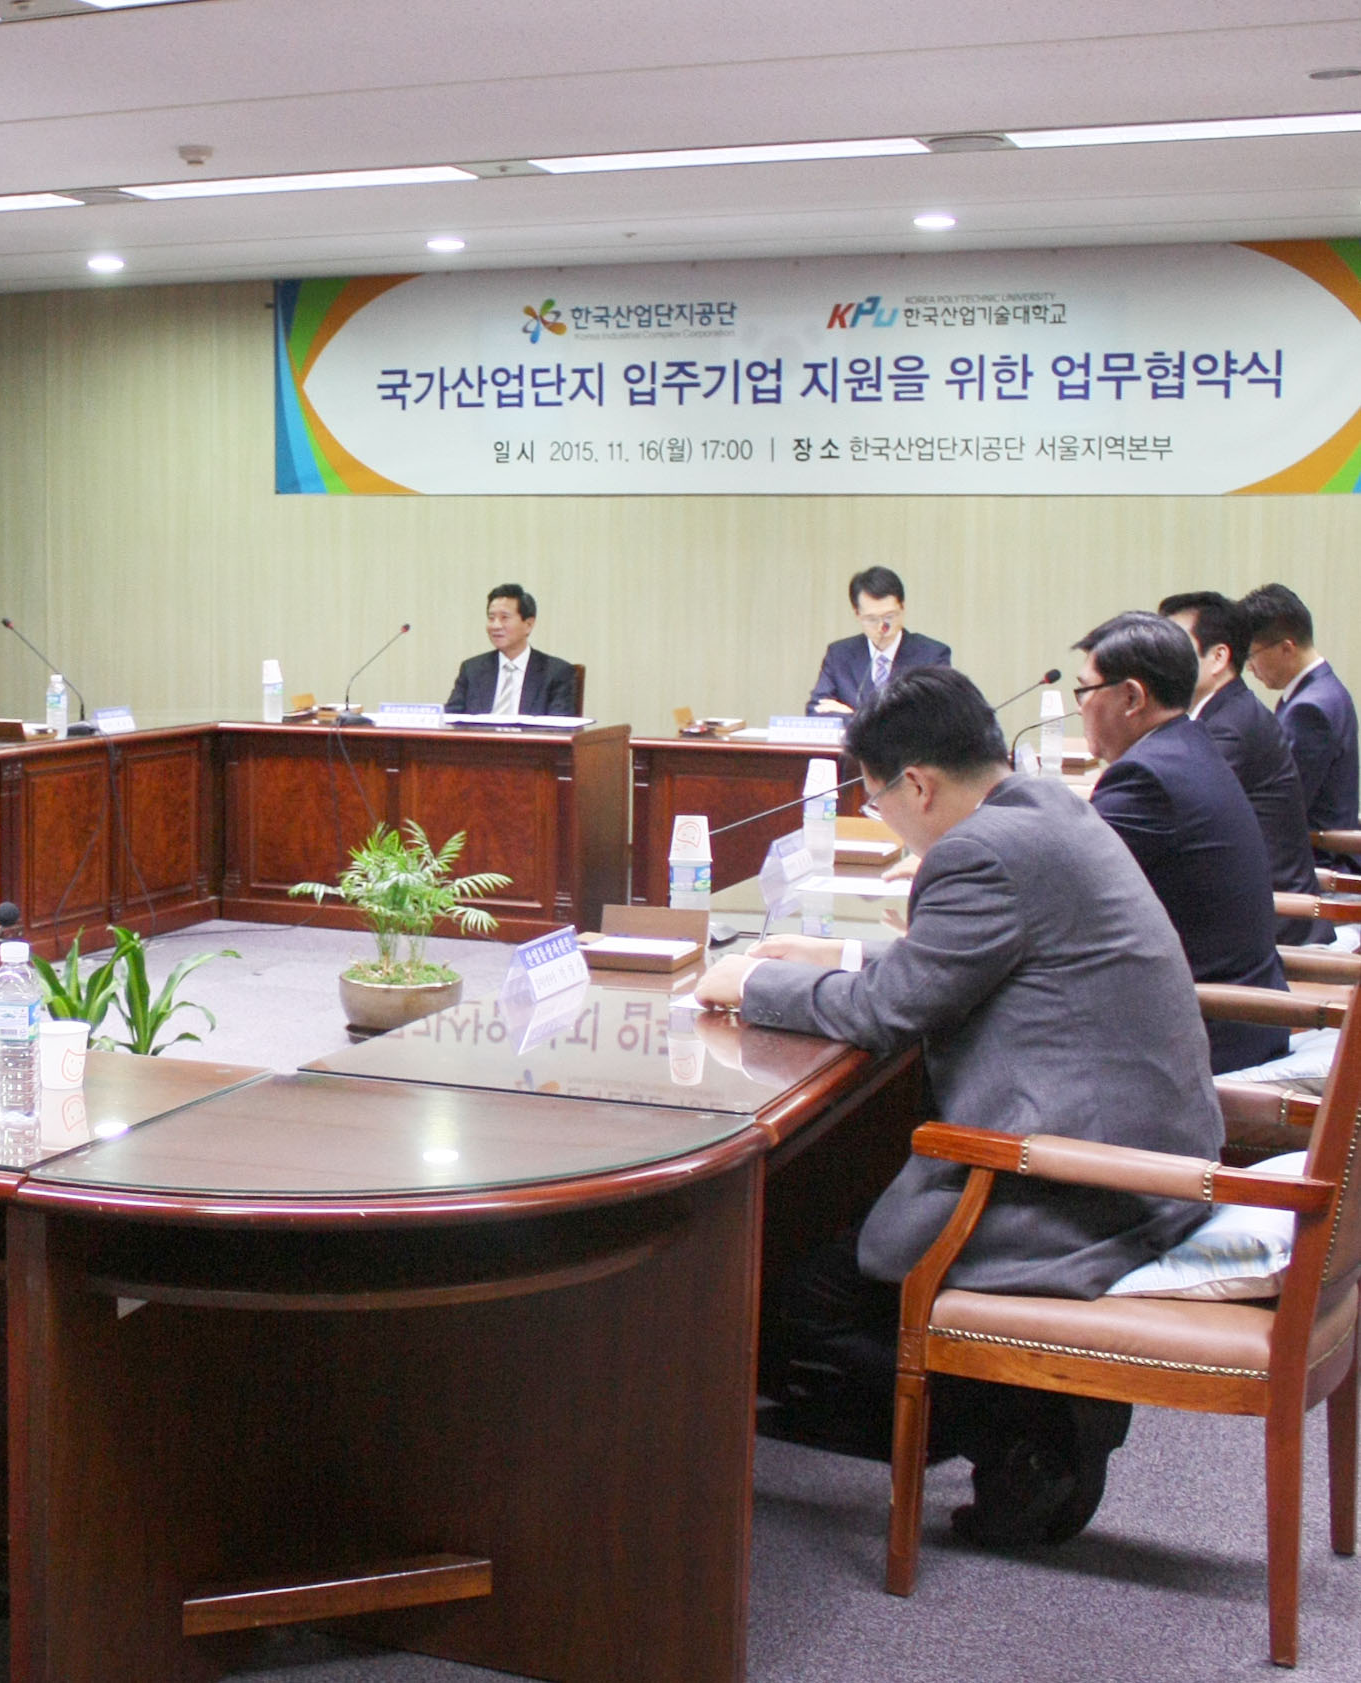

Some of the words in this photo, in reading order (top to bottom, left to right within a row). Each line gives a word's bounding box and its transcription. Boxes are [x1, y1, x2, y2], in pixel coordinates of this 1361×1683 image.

[570, 301, 737, 330] 한국산업단지공단
[903, 303, 1067, 328] 한국산업기술대학교
[376, 361, 604, 411] 국가산업단지
[623, 358, 783, 407] 입주기업
[799, 355, 931, 404] 지원을
[944, 353, 1035, 402] 위한
[1050, 349, 1284, 400] 업무협약식
[638, 438, 693, 463] 16(월)
[701, 438, 754, 461] 17:00
[849, 435, 1026, 462] 한국산업단지공단
[1035, 434, 1174, 462] 서울지역본부
